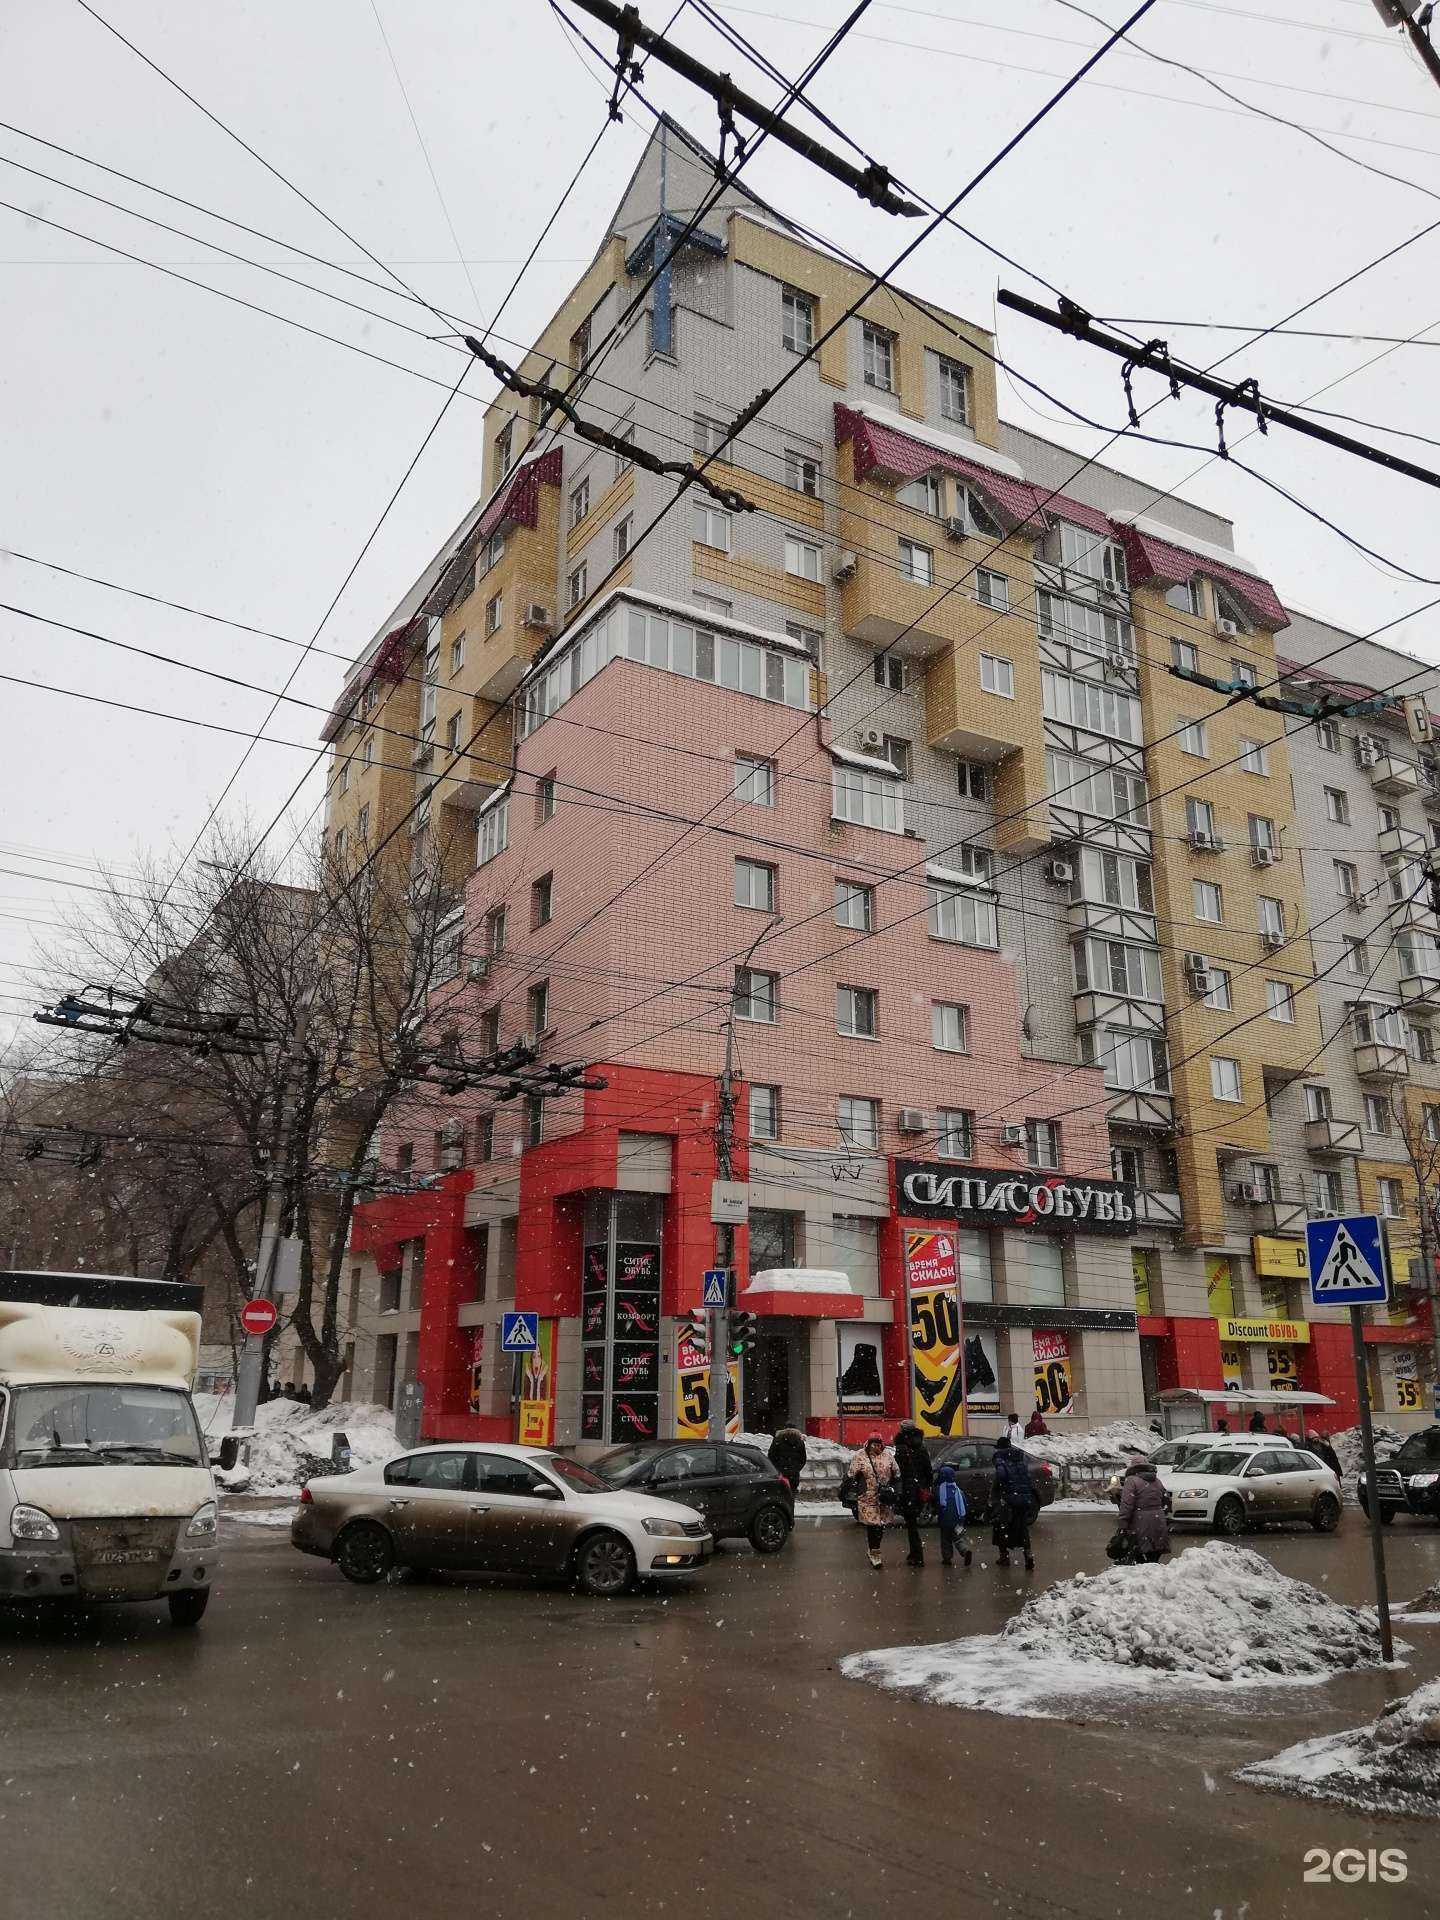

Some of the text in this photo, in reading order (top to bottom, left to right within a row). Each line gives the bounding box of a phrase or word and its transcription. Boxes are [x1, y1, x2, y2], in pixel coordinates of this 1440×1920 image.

[909, 1258, 938, 1271] ВРЕМЯ
[911, 1266, 955, 1281] СКИДОК
[622, 1367, 649, 1375] ОБУВЬ
